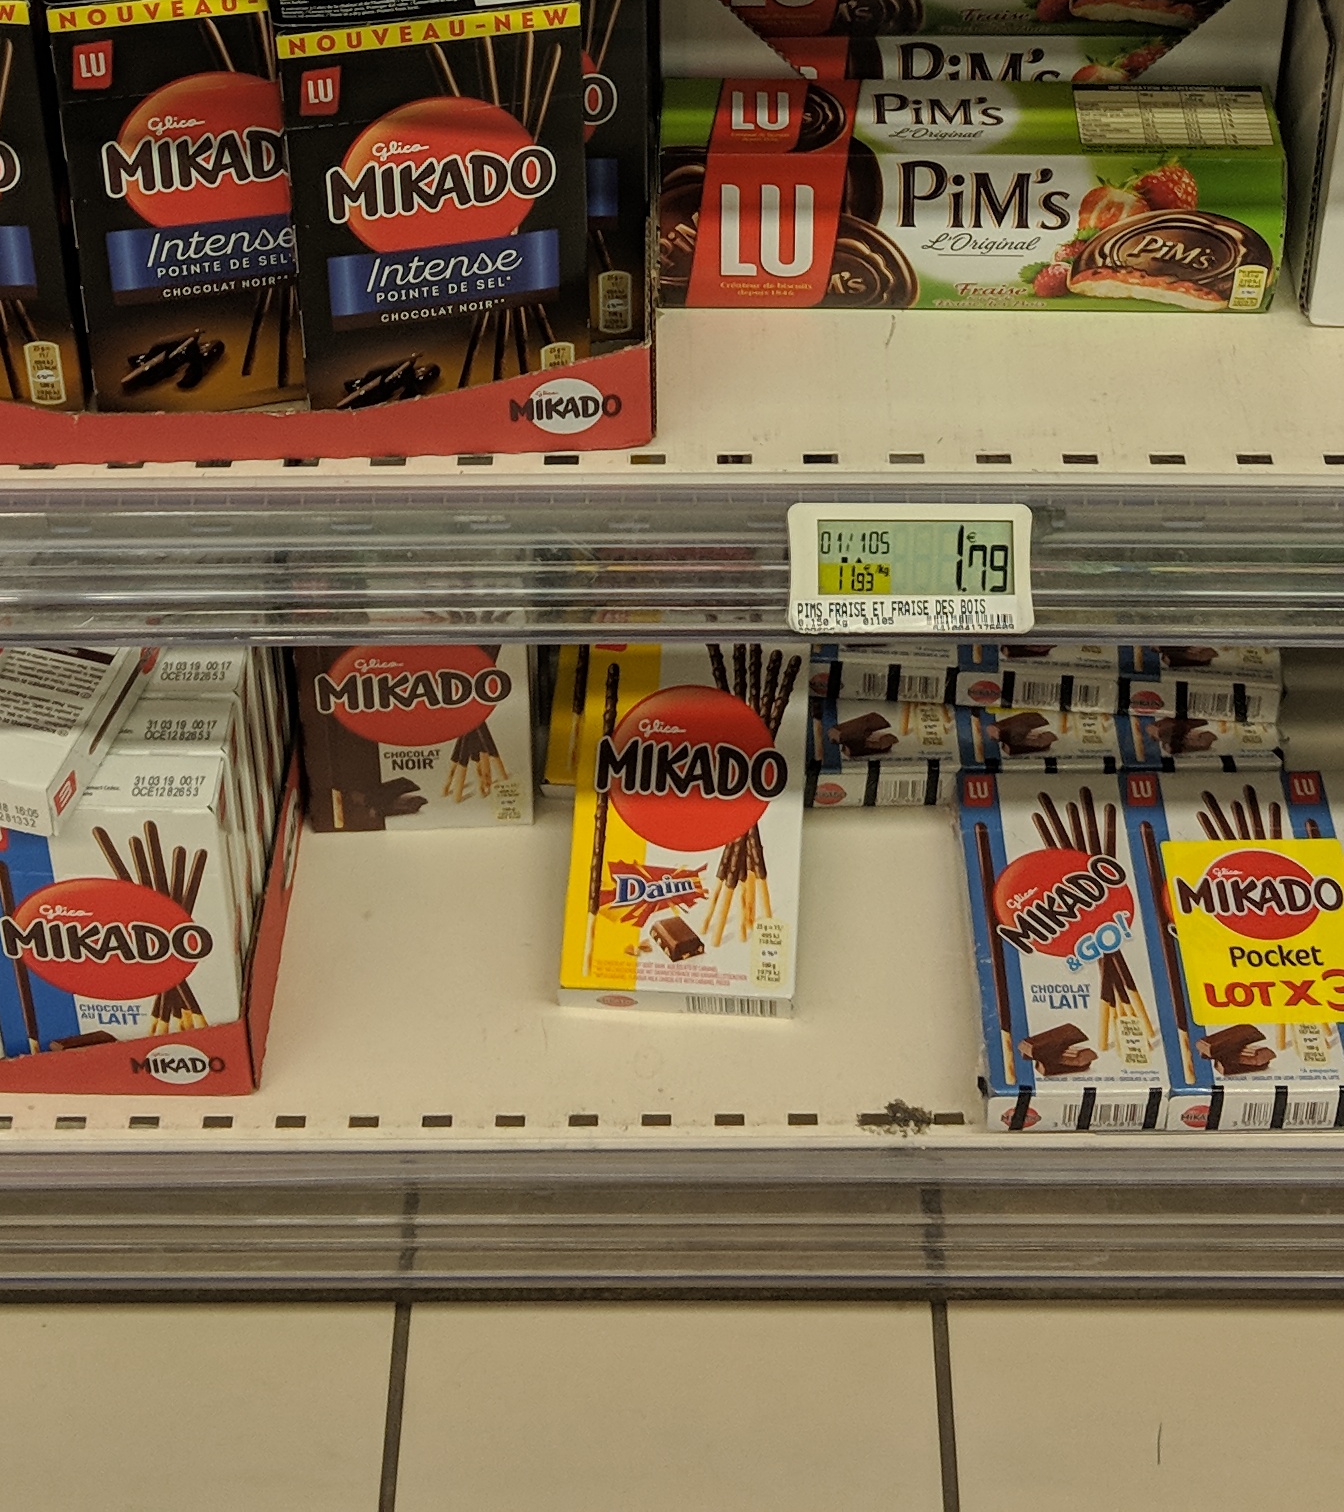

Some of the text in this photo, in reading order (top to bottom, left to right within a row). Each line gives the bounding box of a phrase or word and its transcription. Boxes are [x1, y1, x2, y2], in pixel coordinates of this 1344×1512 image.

[80, 53, 106, 78] LU
[325, 145, 556, 224] MIKADO
[896, 160, 1070, 230] PiM's
[721, 184, 814, 277] LU
[921, 232, 1042, 254] L'Original
[367, 249, 523, 293] Intense
[954, 282, 1028, 297] Fraise
[797, 599, 986, 617] PIMS FRAISE ET FRAISE DES BOIS
[391, 757, 435, 772] NOIR
[614, 873, 695, 907] Daim
[0, 916, 213, 964] MIKADO
[1229, 945, 1324, 968] Pocket
[79, 1004, 141, 1012] CHOCOLAT
